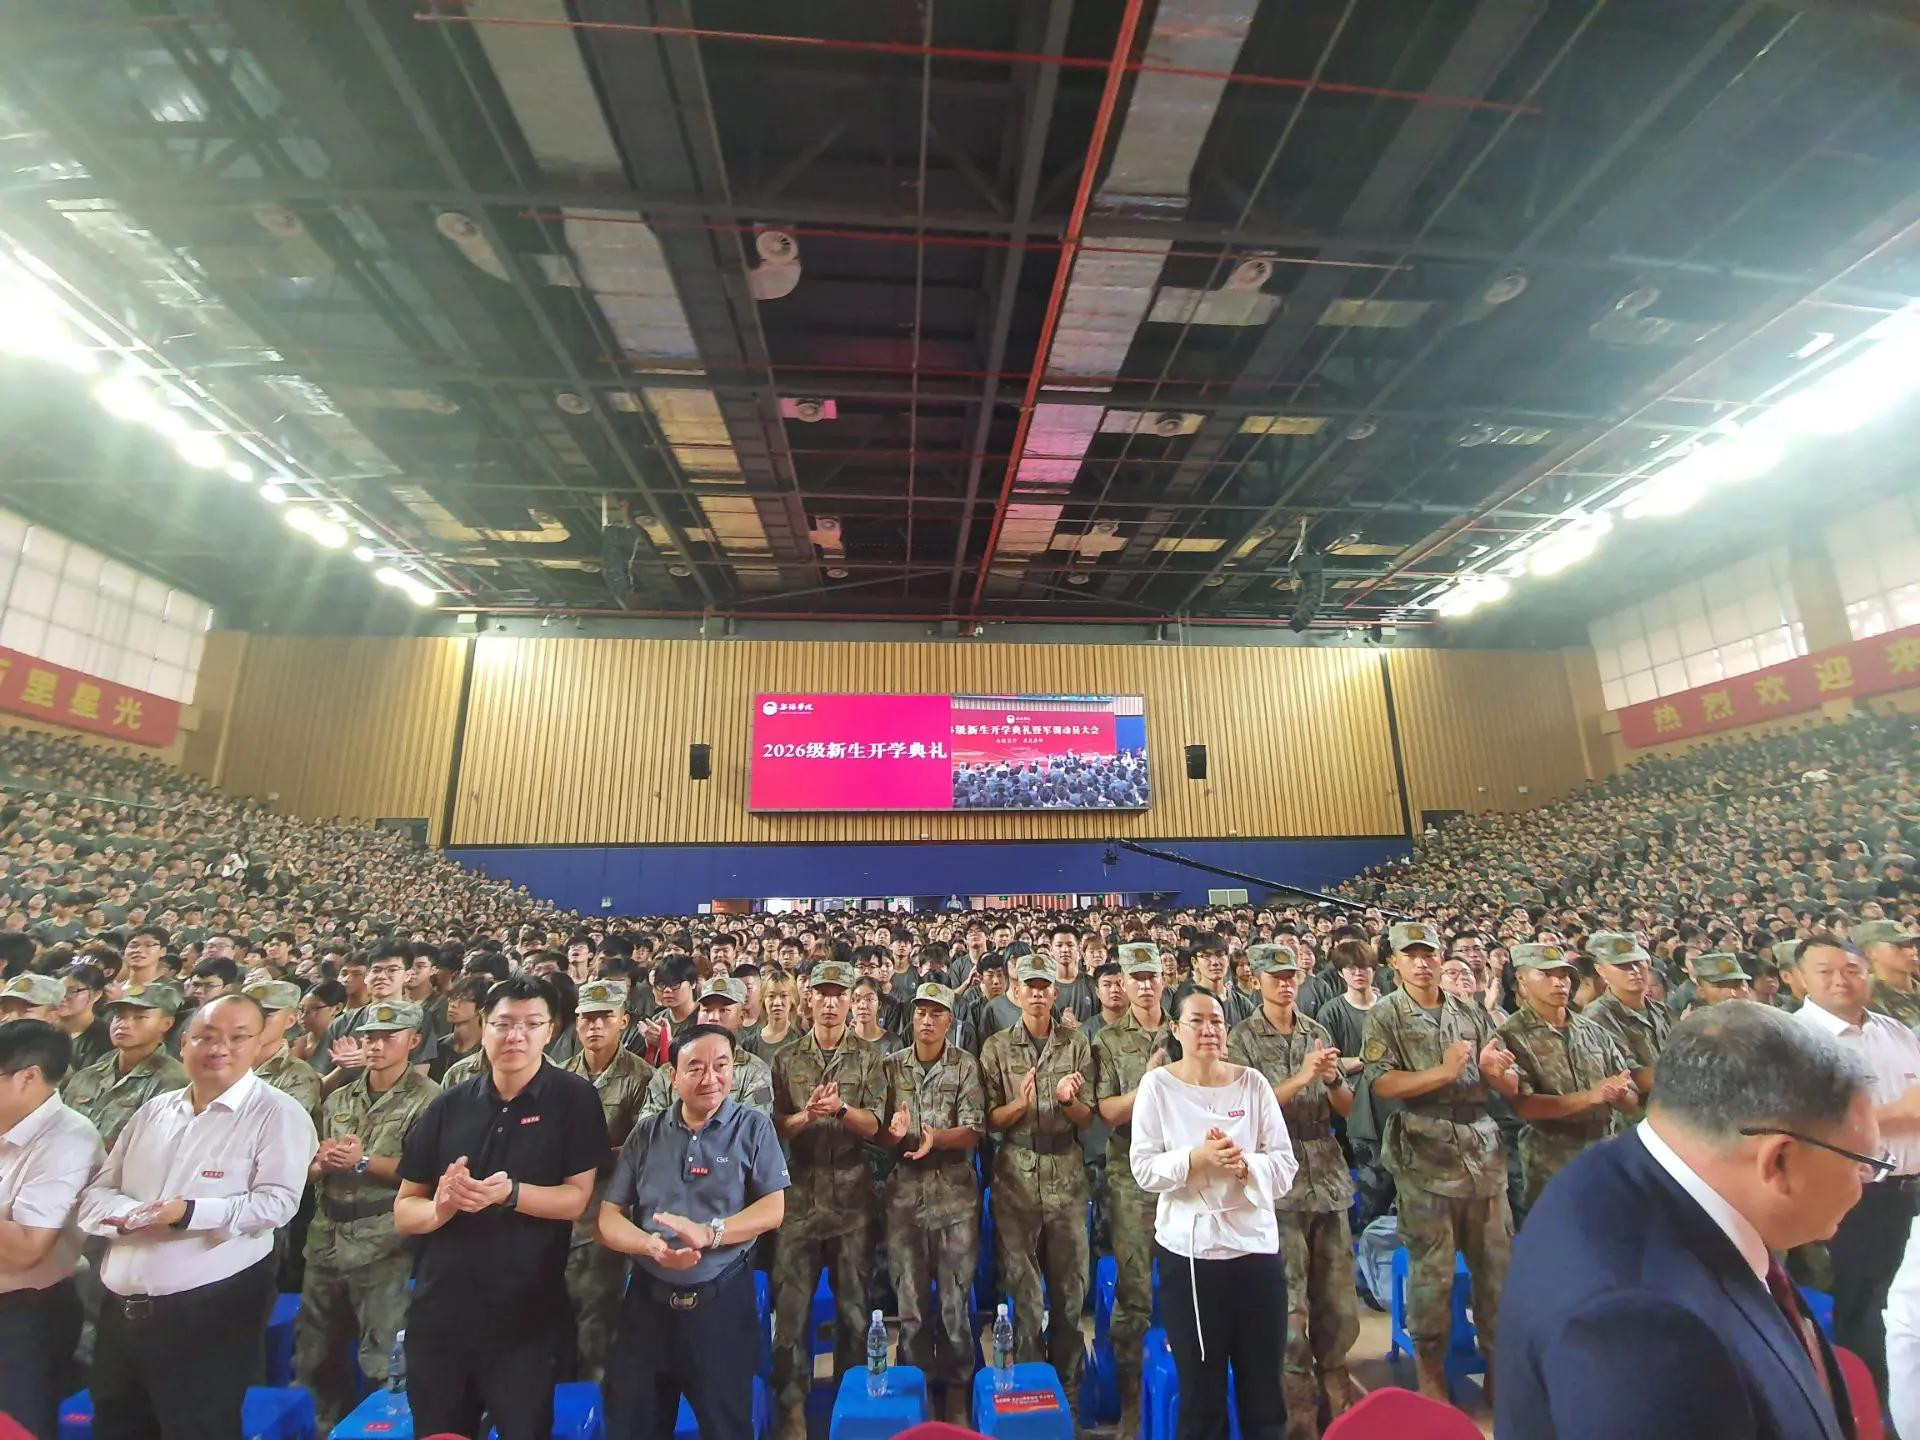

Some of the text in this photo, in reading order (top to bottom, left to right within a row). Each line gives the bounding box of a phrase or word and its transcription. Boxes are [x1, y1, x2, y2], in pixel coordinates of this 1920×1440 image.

[762, 741, 948, 760] 2026级新生开学典礼
